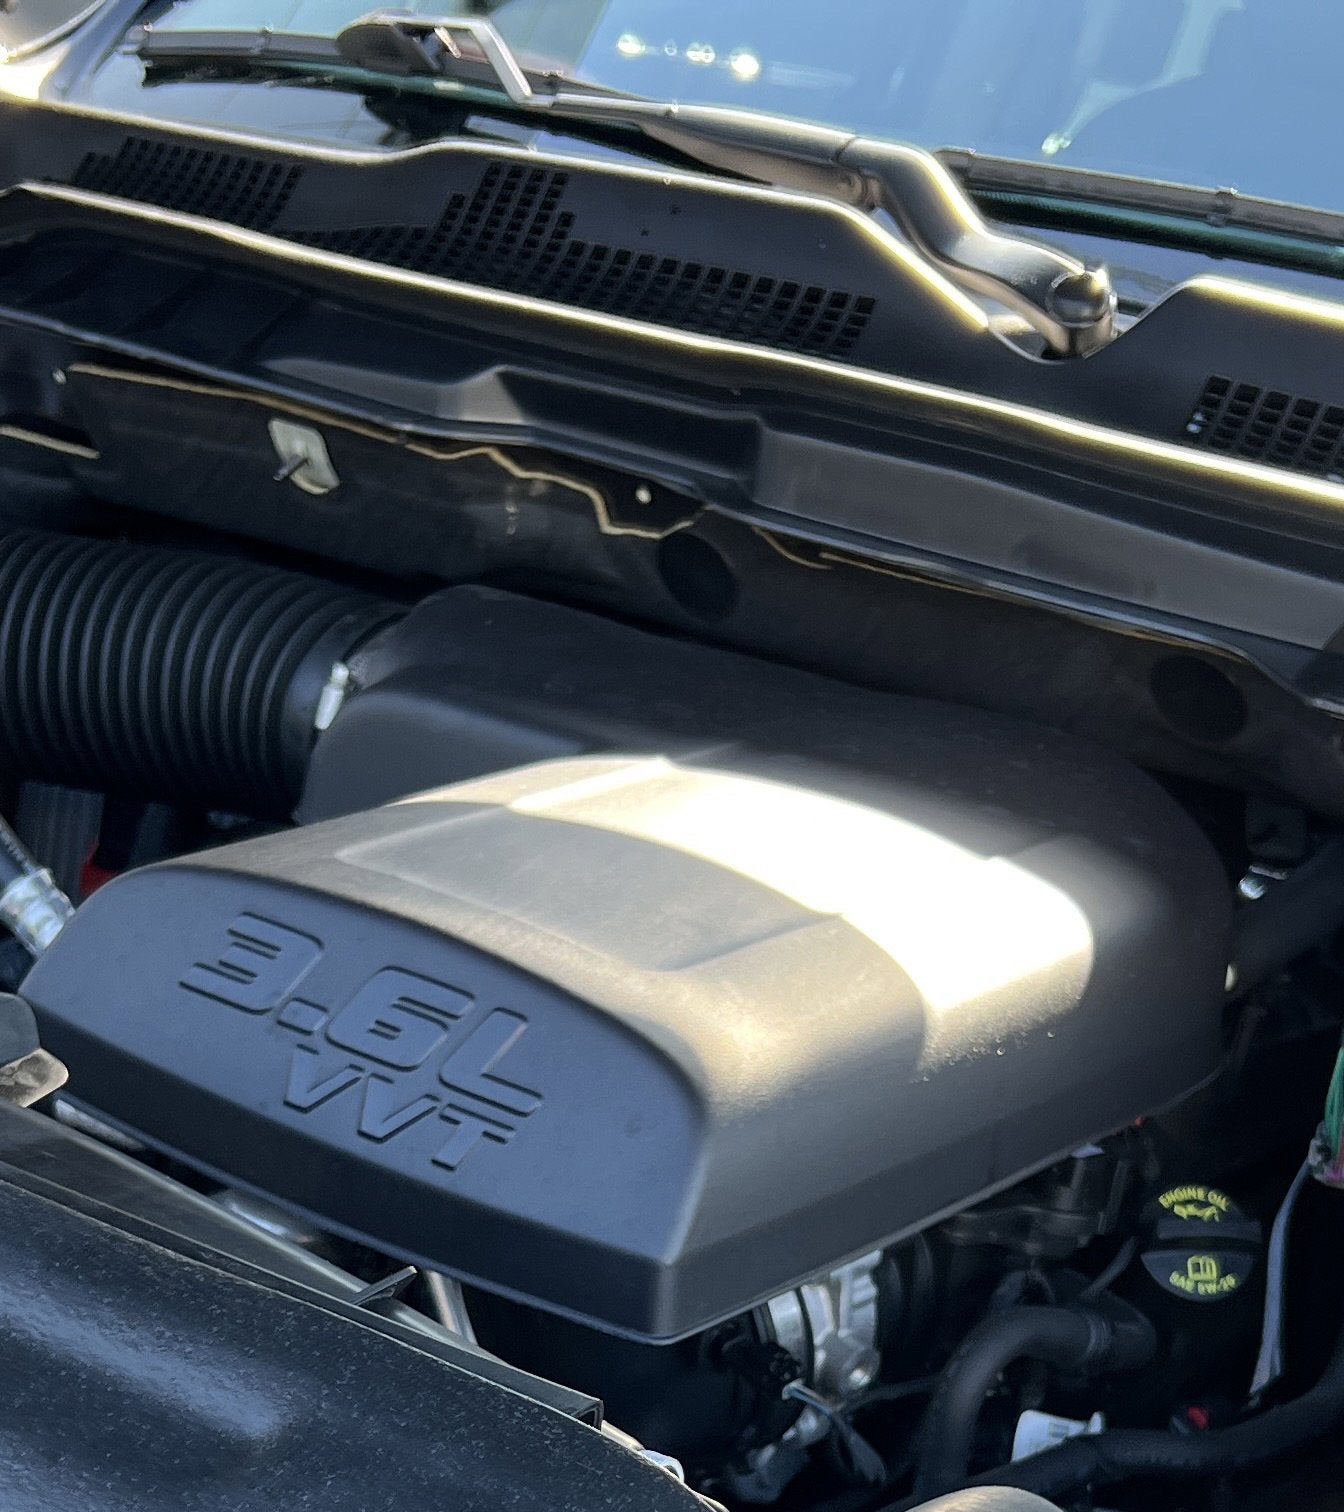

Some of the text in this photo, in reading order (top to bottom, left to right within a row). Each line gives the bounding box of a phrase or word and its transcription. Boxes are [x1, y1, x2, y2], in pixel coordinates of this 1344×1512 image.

[178, 910, 544, 1118] 3.6L
[283, 1043, 517, 1172] VVT
[1159, 1187, 1228, 1212] ENGINE OIL
[1169, 1271, 1194, 1293] SAE
